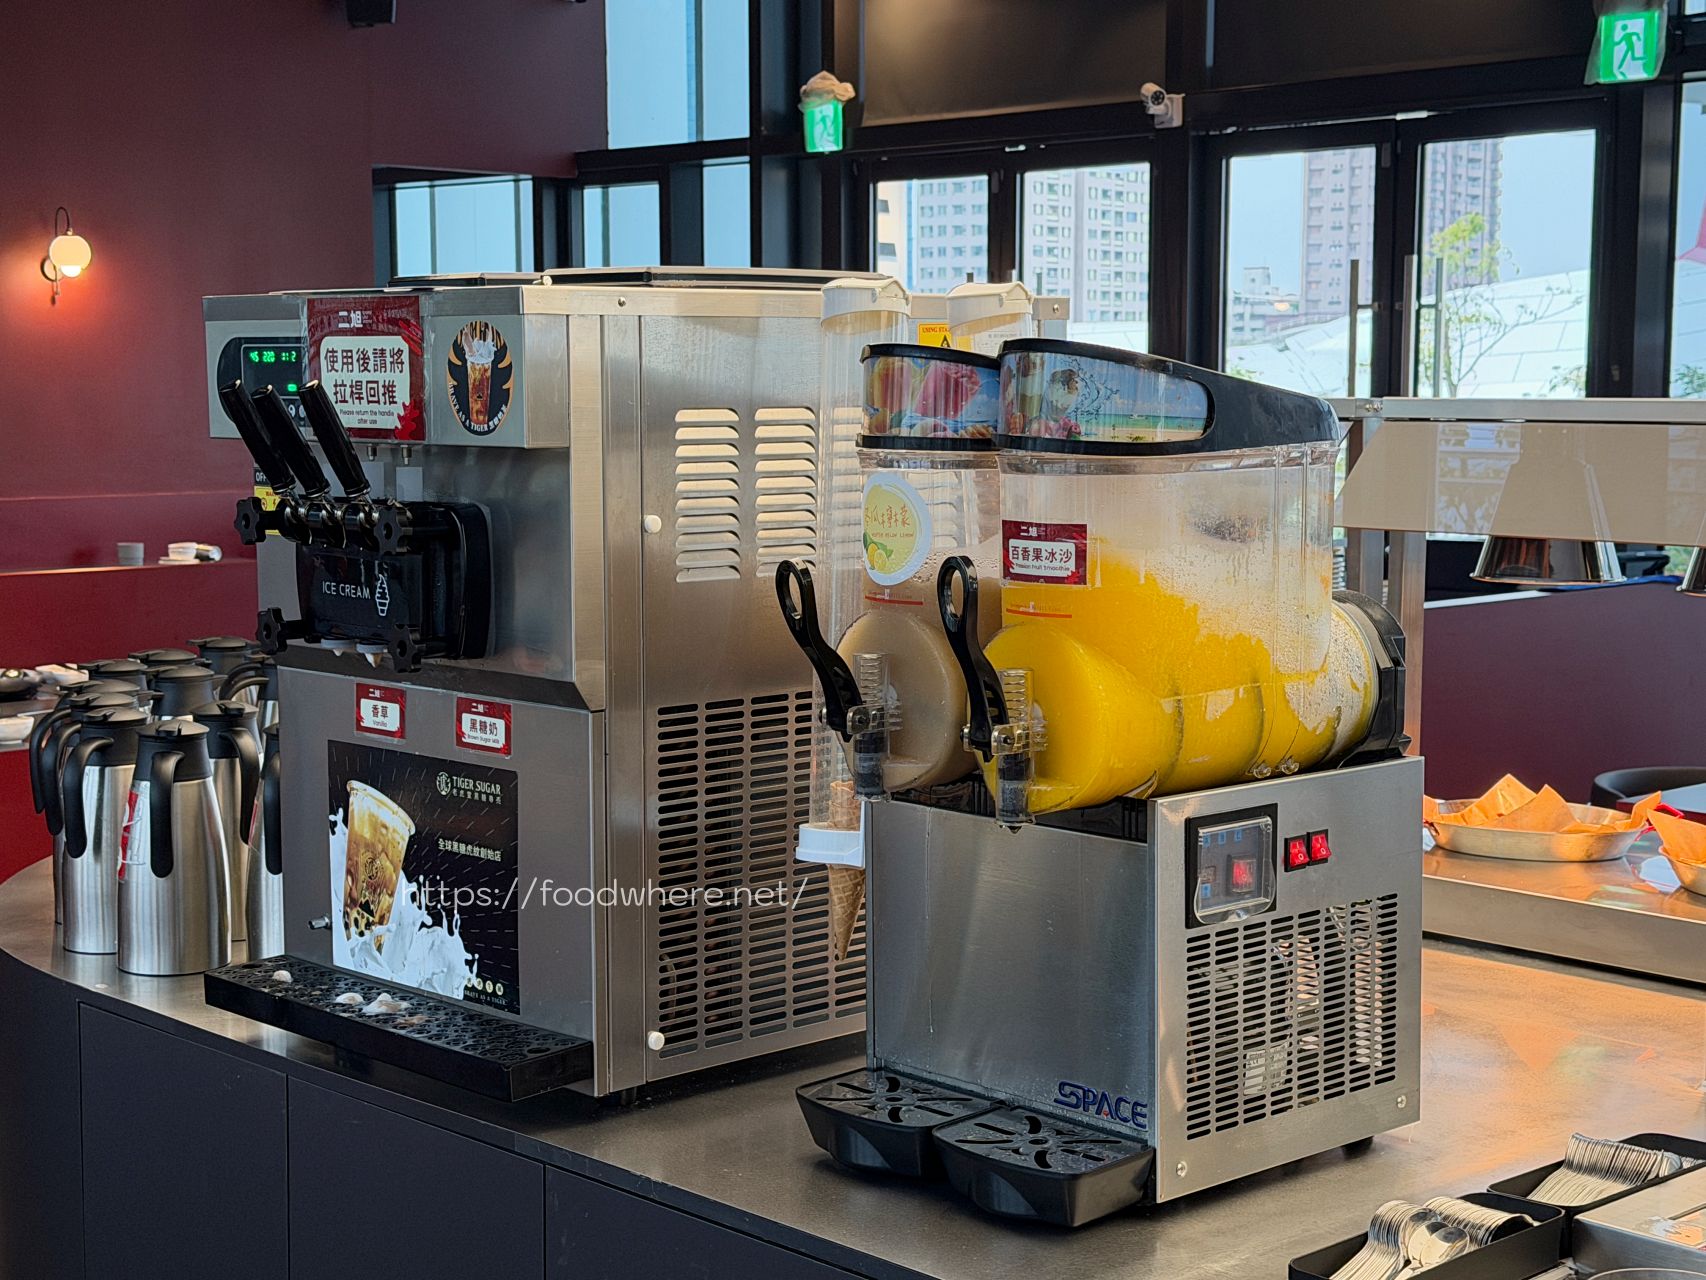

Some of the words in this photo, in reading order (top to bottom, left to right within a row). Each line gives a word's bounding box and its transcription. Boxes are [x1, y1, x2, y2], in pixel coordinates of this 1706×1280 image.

[338, 310, 363, 328] 二旭
[324, 347, 405, 374] 使用後請將
[333, 379, 398, 405] 拉桿回推
[357, 417, 368, 425] after
[378, 409, 394, 417] handle
[471, 421, 488, 432] TIGER
[1011, 545, 1073, 563] 百香果冰沙
[322, 580, 337, 595] ICE
[339, 583, 371, 600] CREAM
[371, 704, 389, 719] 香草
[373, 720, 388, 728] Vanilla
[469, 718, 498, 737] 黑糖奶
[452, 775, 474, 790] TIGER
[475, 780, 501, 795] SUGAR
[1053, 1080, 1148, 1130] SPACE
